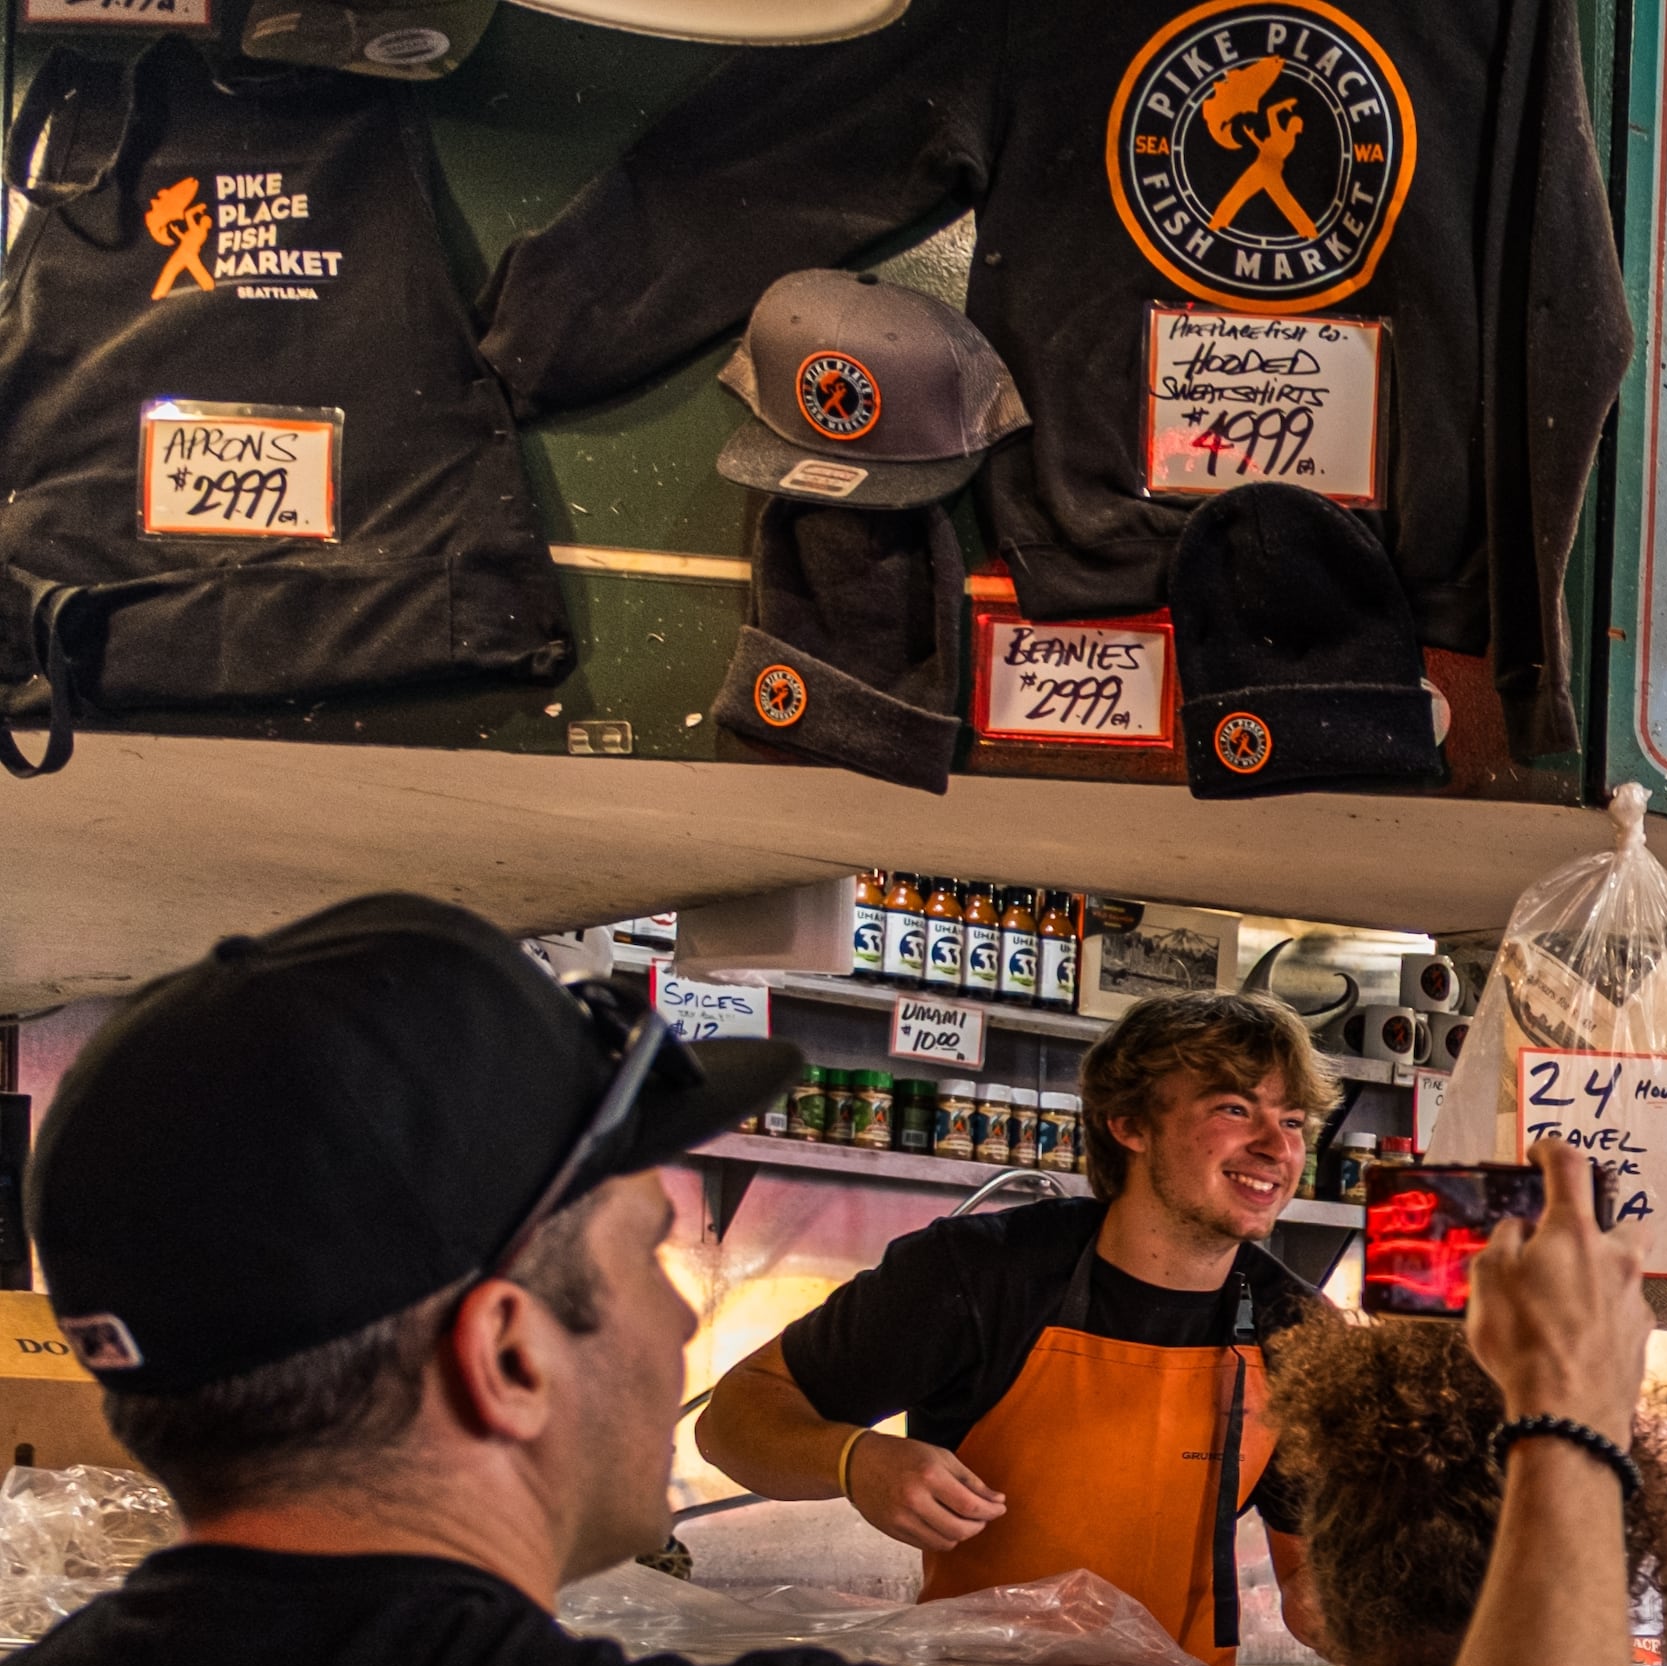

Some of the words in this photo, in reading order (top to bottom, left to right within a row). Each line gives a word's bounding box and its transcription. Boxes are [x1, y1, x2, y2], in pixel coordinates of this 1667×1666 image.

[1147, 31, 1239, 119] PIKE
[1267, 23, 1381, 123] PLACE
[1135, 136, 1170, 155] SEA
[1354, 144, 1385, 163] WA
[216, 173, 282, 200] PIKE
[218, 194, 309, 228] PLACE
[1143, 172, 1215, 259] FISH
[1234, 182, 1375, 280] MARKET
[218, 224, 277, 254] FISH
[214, 250, 343, 279] MARKET
[1173, 341, 1321, 379] HOODED
[1150, 376, 1330, 407] SWEATSHIRTS
[164, 427, 299, 464] APRONS
[1004, 627, 1145, 670] BEANIES
[664, 982, 755, 1014] SPICES
[901, 1003, 967, 1030] UMAMI
[1528, 1061, 1620, 1111] 24
